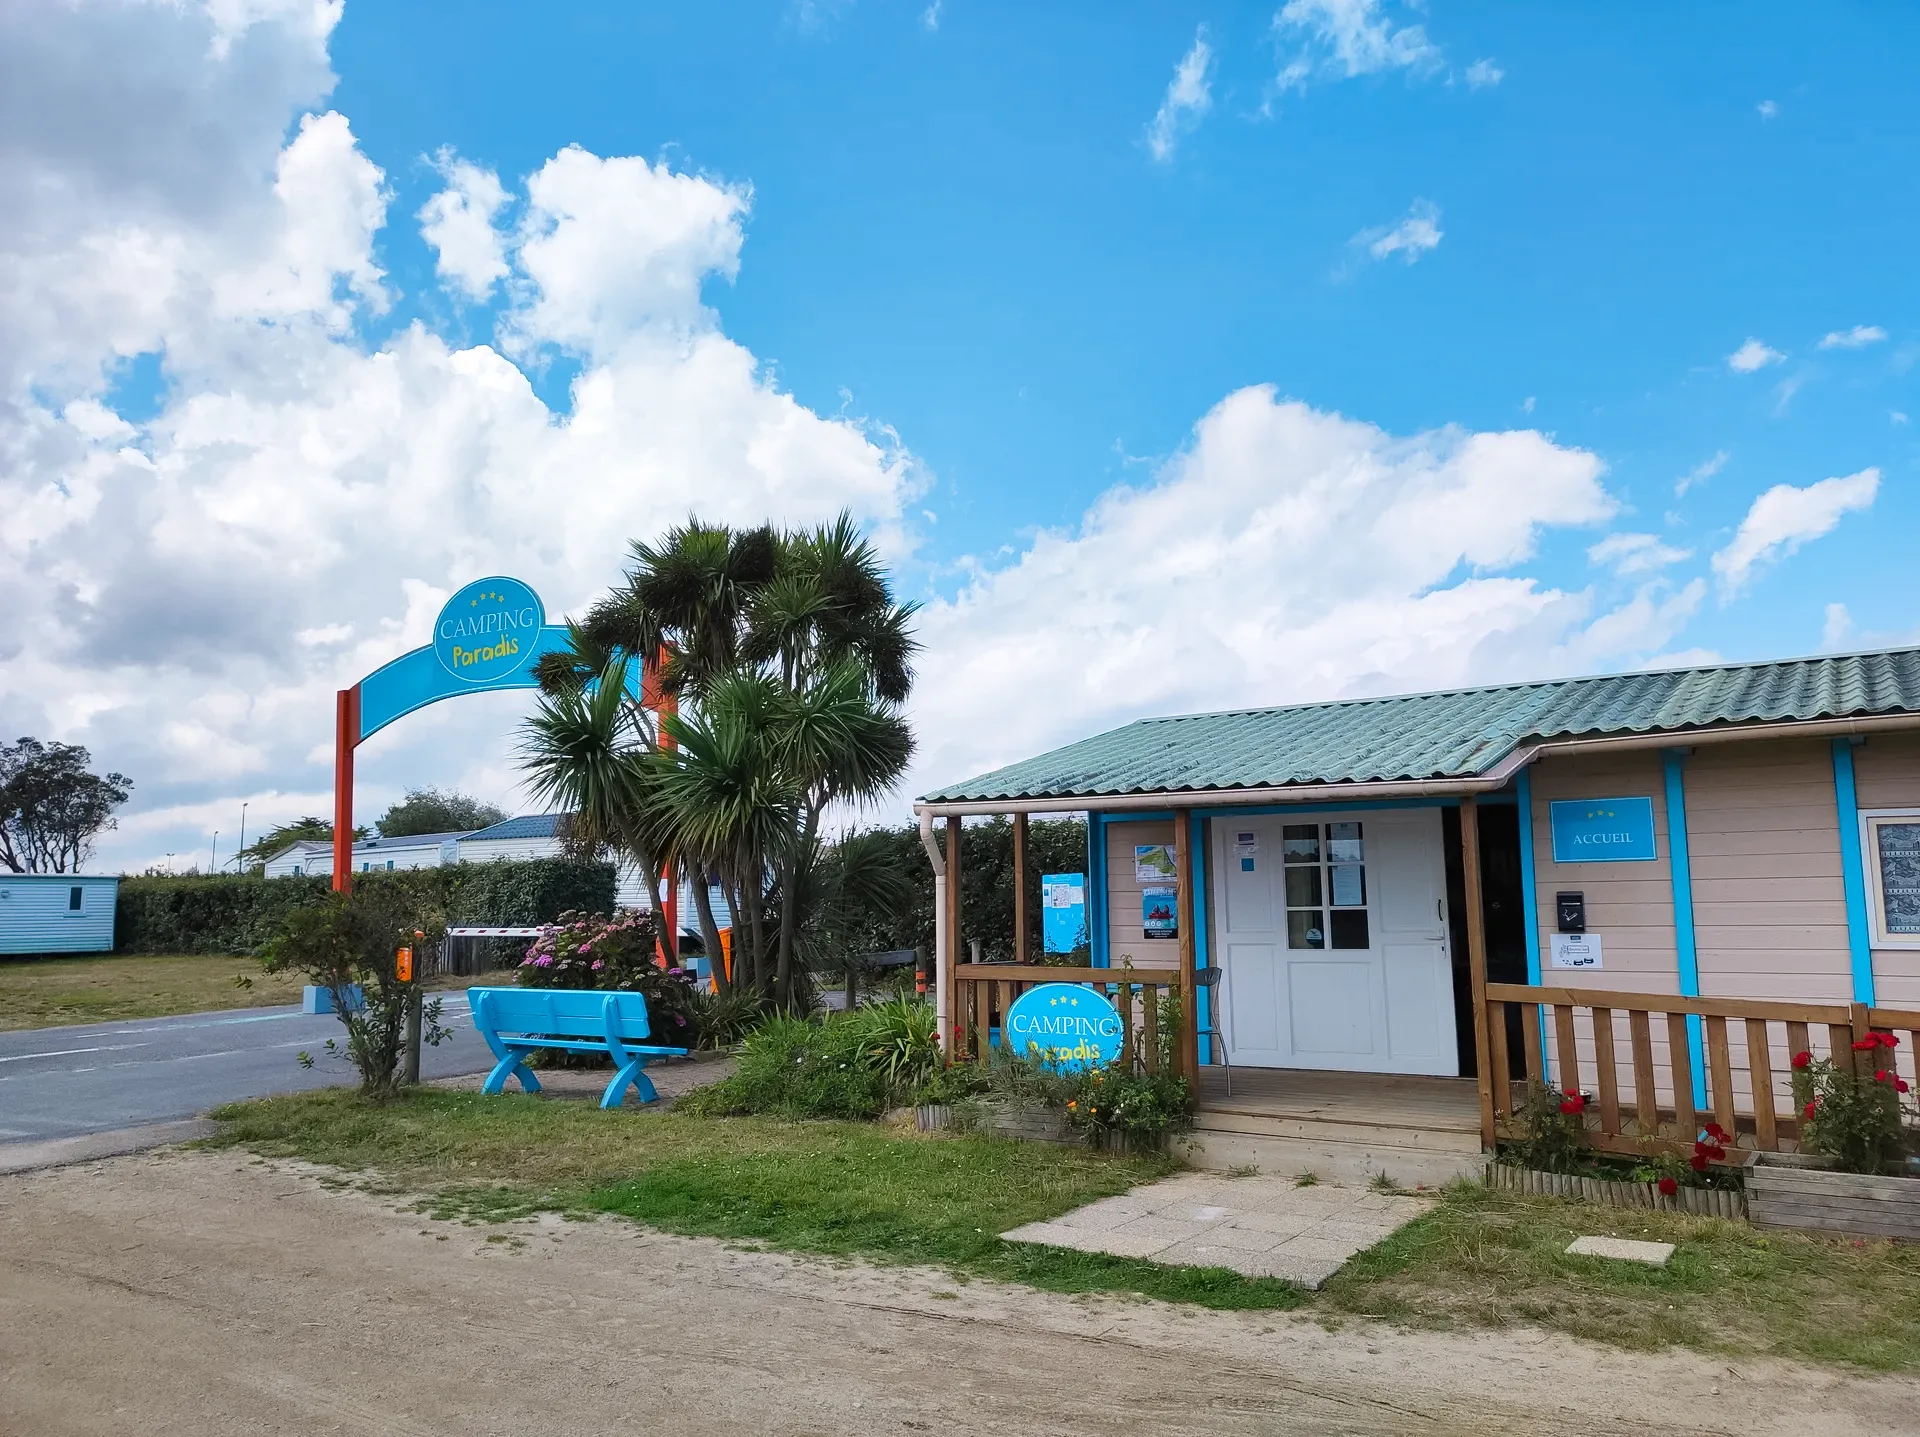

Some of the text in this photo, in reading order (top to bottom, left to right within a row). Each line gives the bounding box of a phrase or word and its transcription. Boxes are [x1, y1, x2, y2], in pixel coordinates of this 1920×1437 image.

[440, 607, 533, 639] CAMPING
[453, 634, 519, 668] Paradis
[1573, 832, 1634, 844] ACCUEIL
[1013, 1014, 1117, 1037] CAMPING
